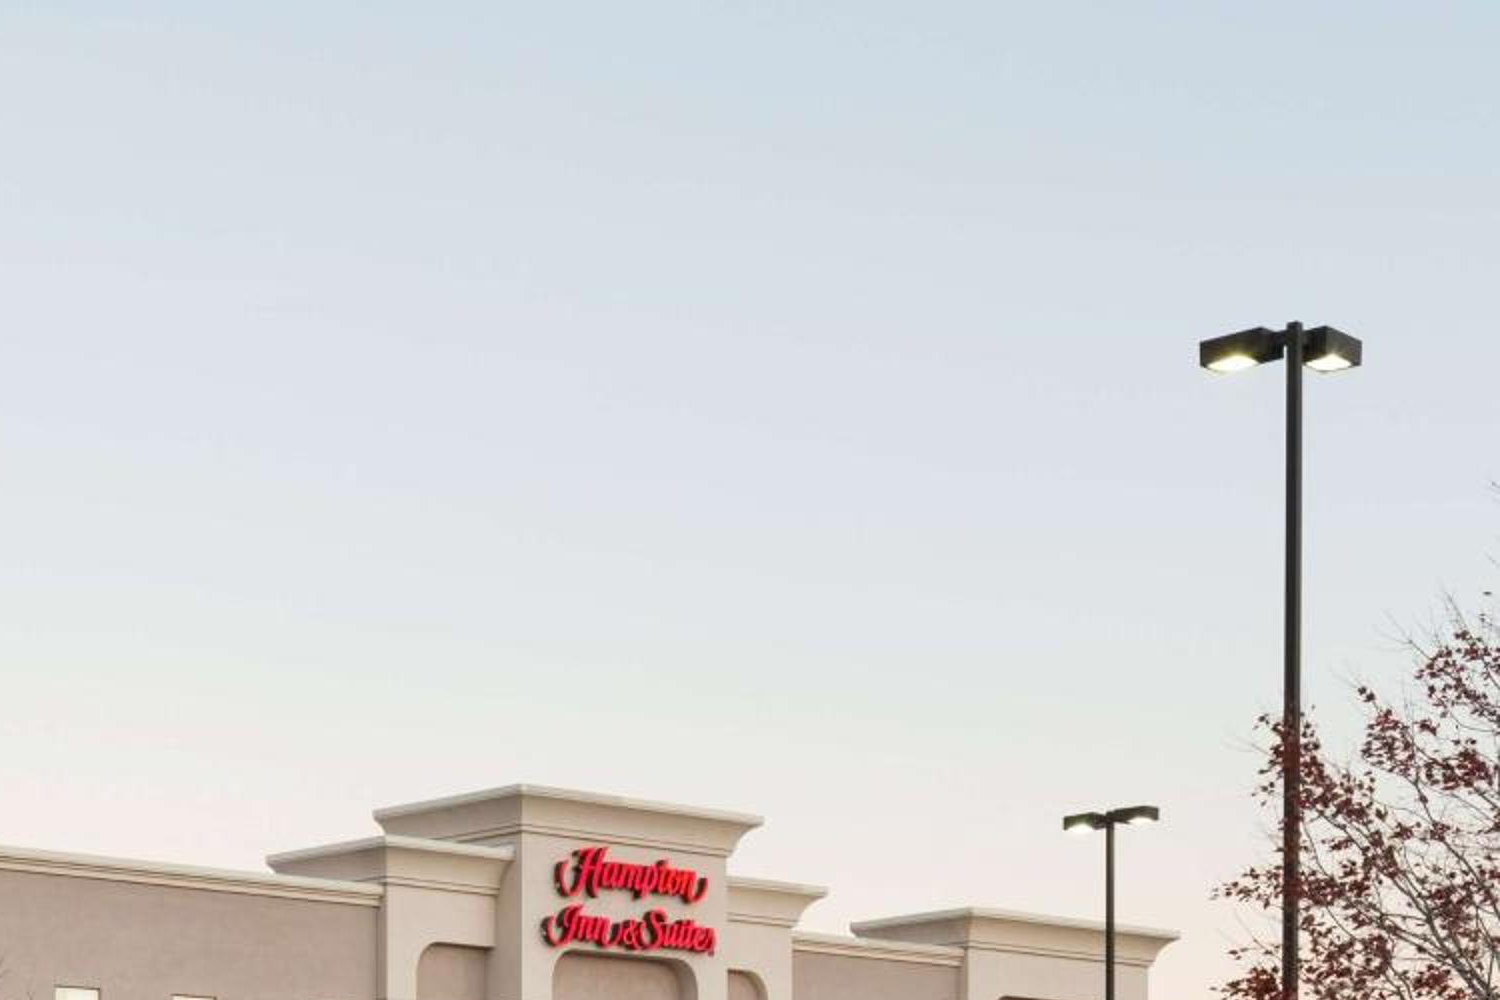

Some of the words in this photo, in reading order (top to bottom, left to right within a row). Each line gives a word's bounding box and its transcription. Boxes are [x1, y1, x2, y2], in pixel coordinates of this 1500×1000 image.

[554, 847, 708, 904] Hampton
[541, 904, 621, 948] Inn
[621, 918, 642, 949] &
[640, 907, 716, 956] Suites
